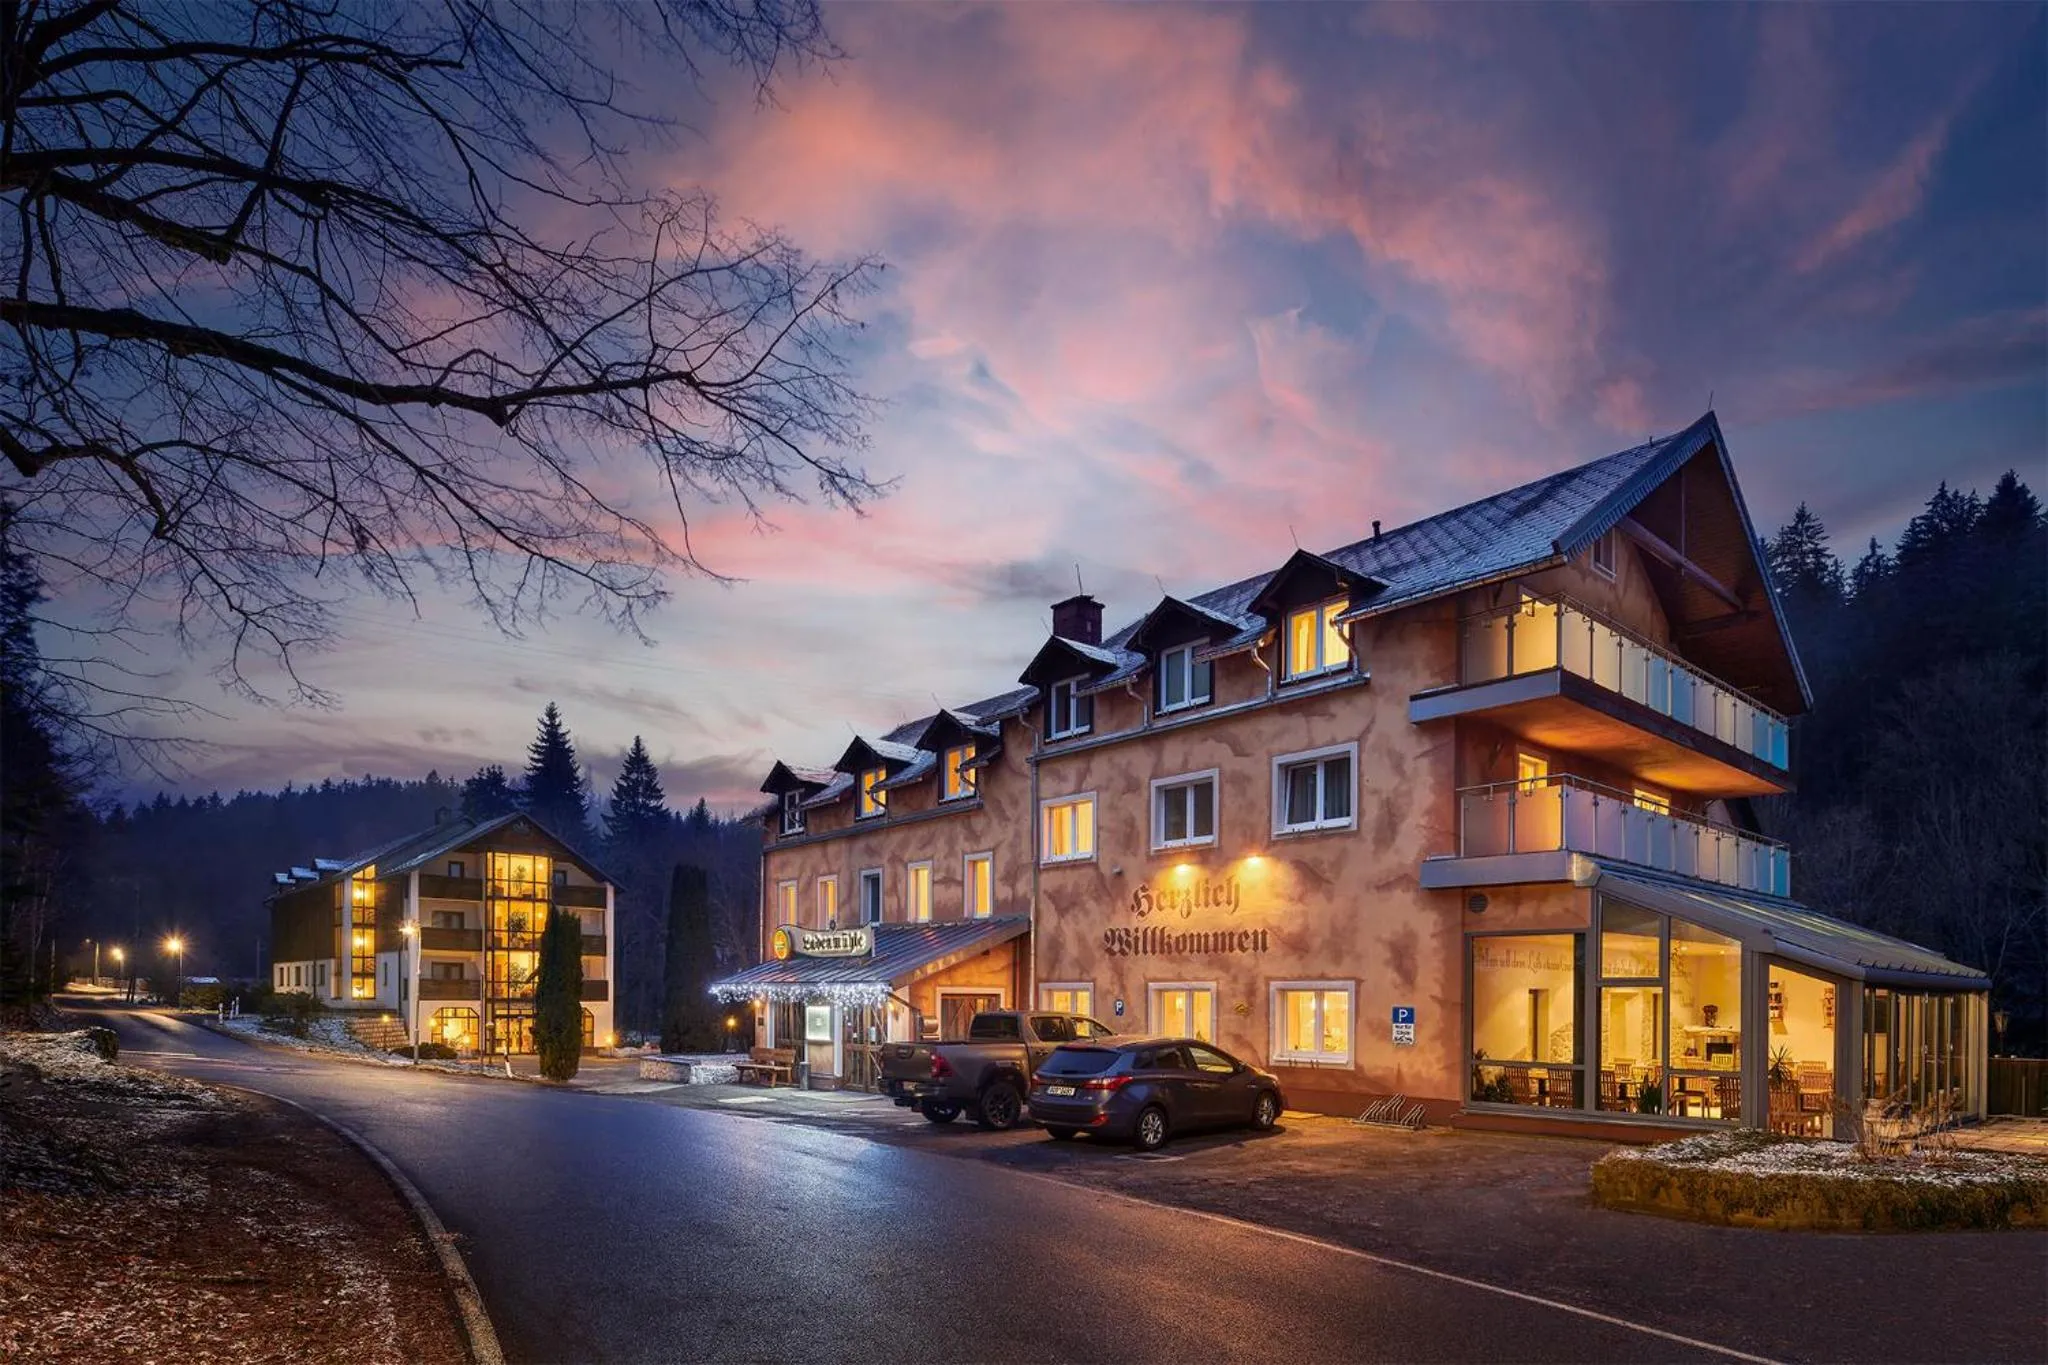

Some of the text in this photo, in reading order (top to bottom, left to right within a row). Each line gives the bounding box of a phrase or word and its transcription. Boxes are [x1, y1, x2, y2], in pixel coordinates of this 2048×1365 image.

[1130, 876, 1241, 920] Herzlich
[1103, 926, 1270, 957] Willkommen
[1398, 1009, 1409, 1022] P
